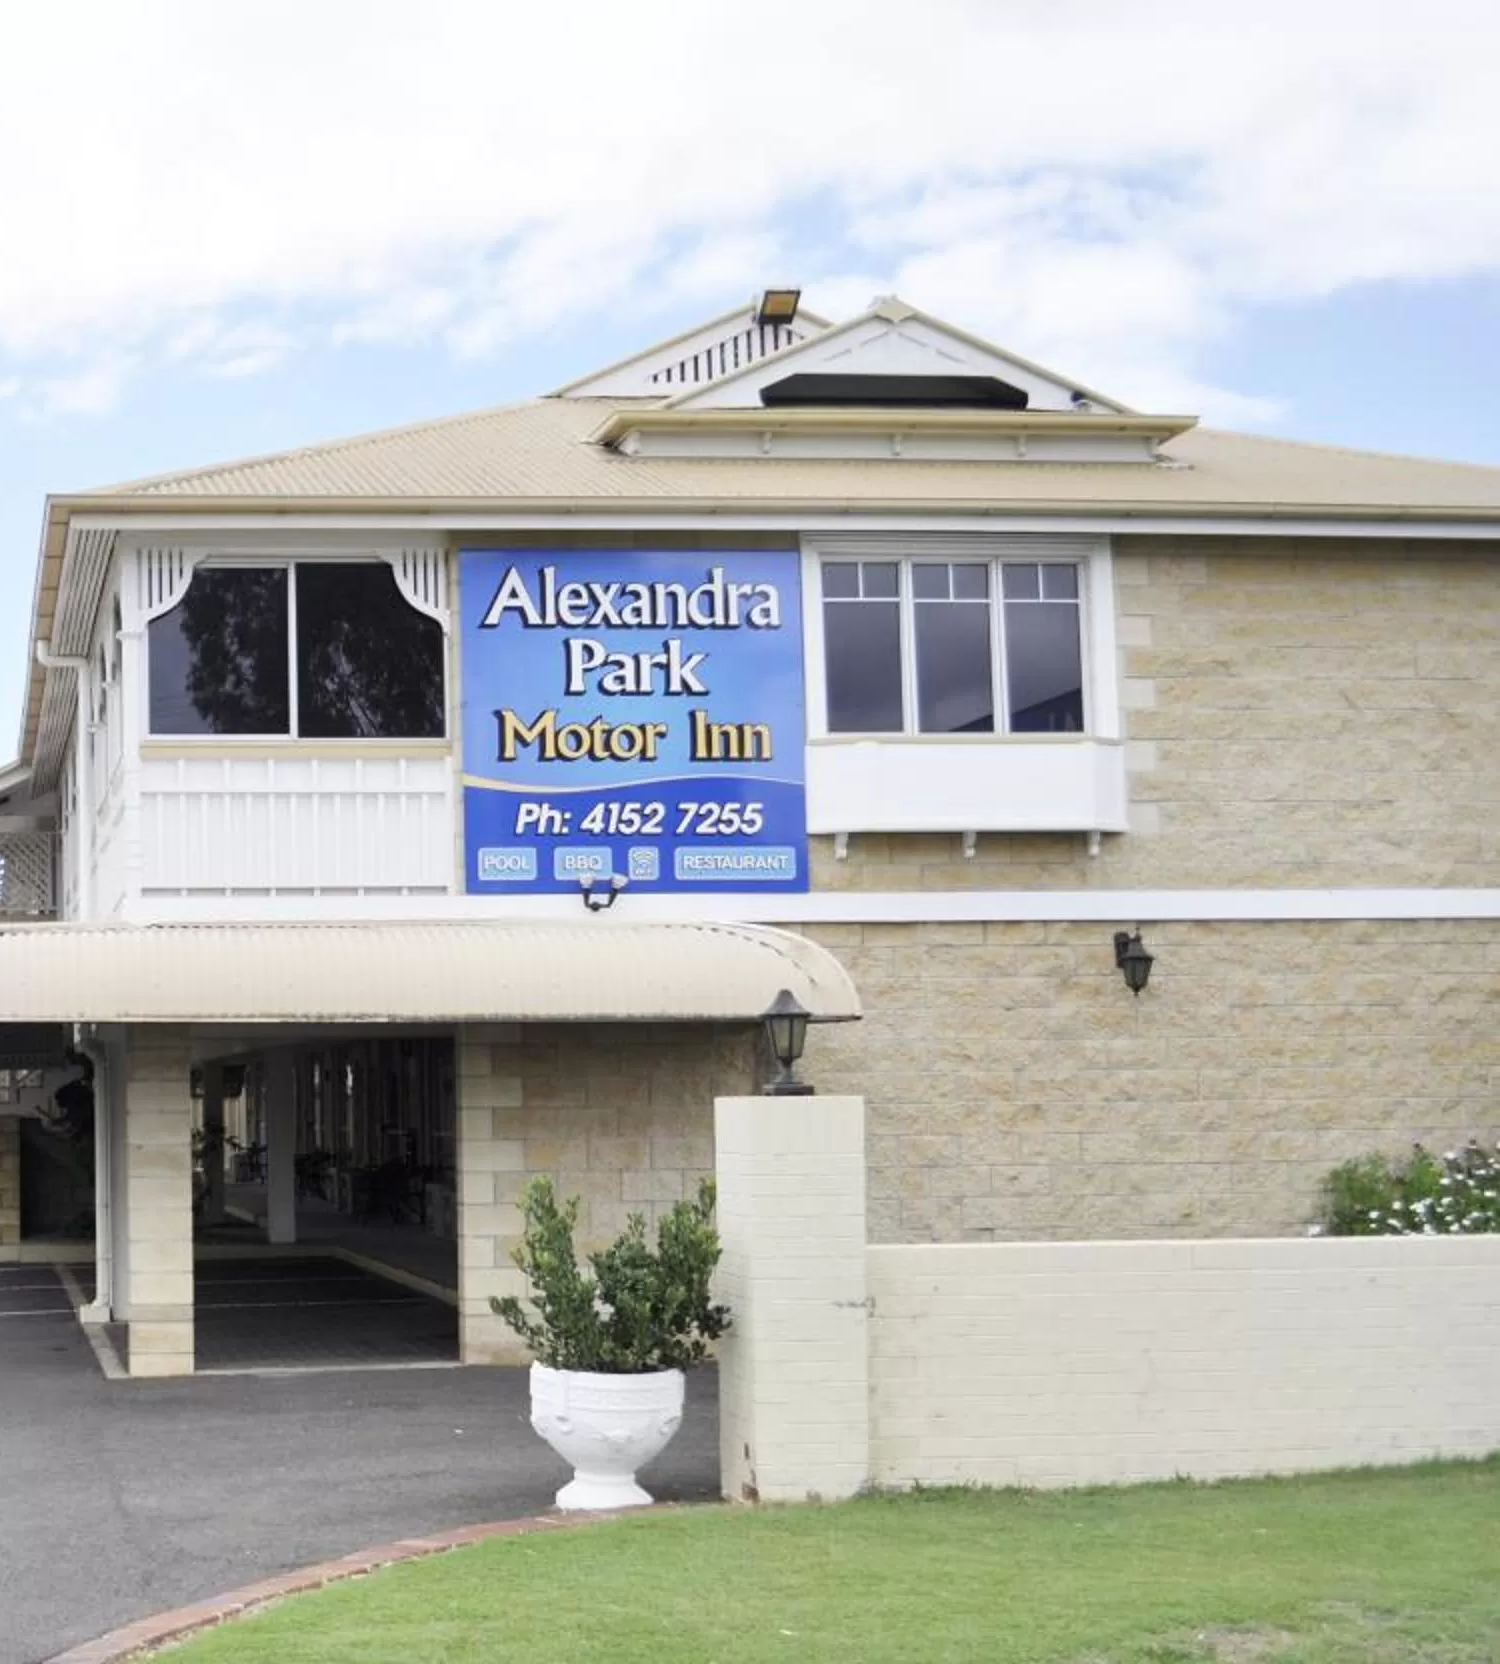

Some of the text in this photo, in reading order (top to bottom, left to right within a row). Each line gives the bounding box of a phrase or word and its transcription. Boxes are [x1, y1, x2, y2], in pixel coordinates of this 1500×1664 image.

[479, 563, 781, 629] Alexandra
[563, 637, 710, 695] Park
[493, 708, 772, 762] Motor Inn
[515, 802, 764, 835] Ph: 4152 7255
[483, 855, 532, 871] POOL
[563, 855, 603, 871] BBQ
[682, 854, 790, 871] RESTAURANT
